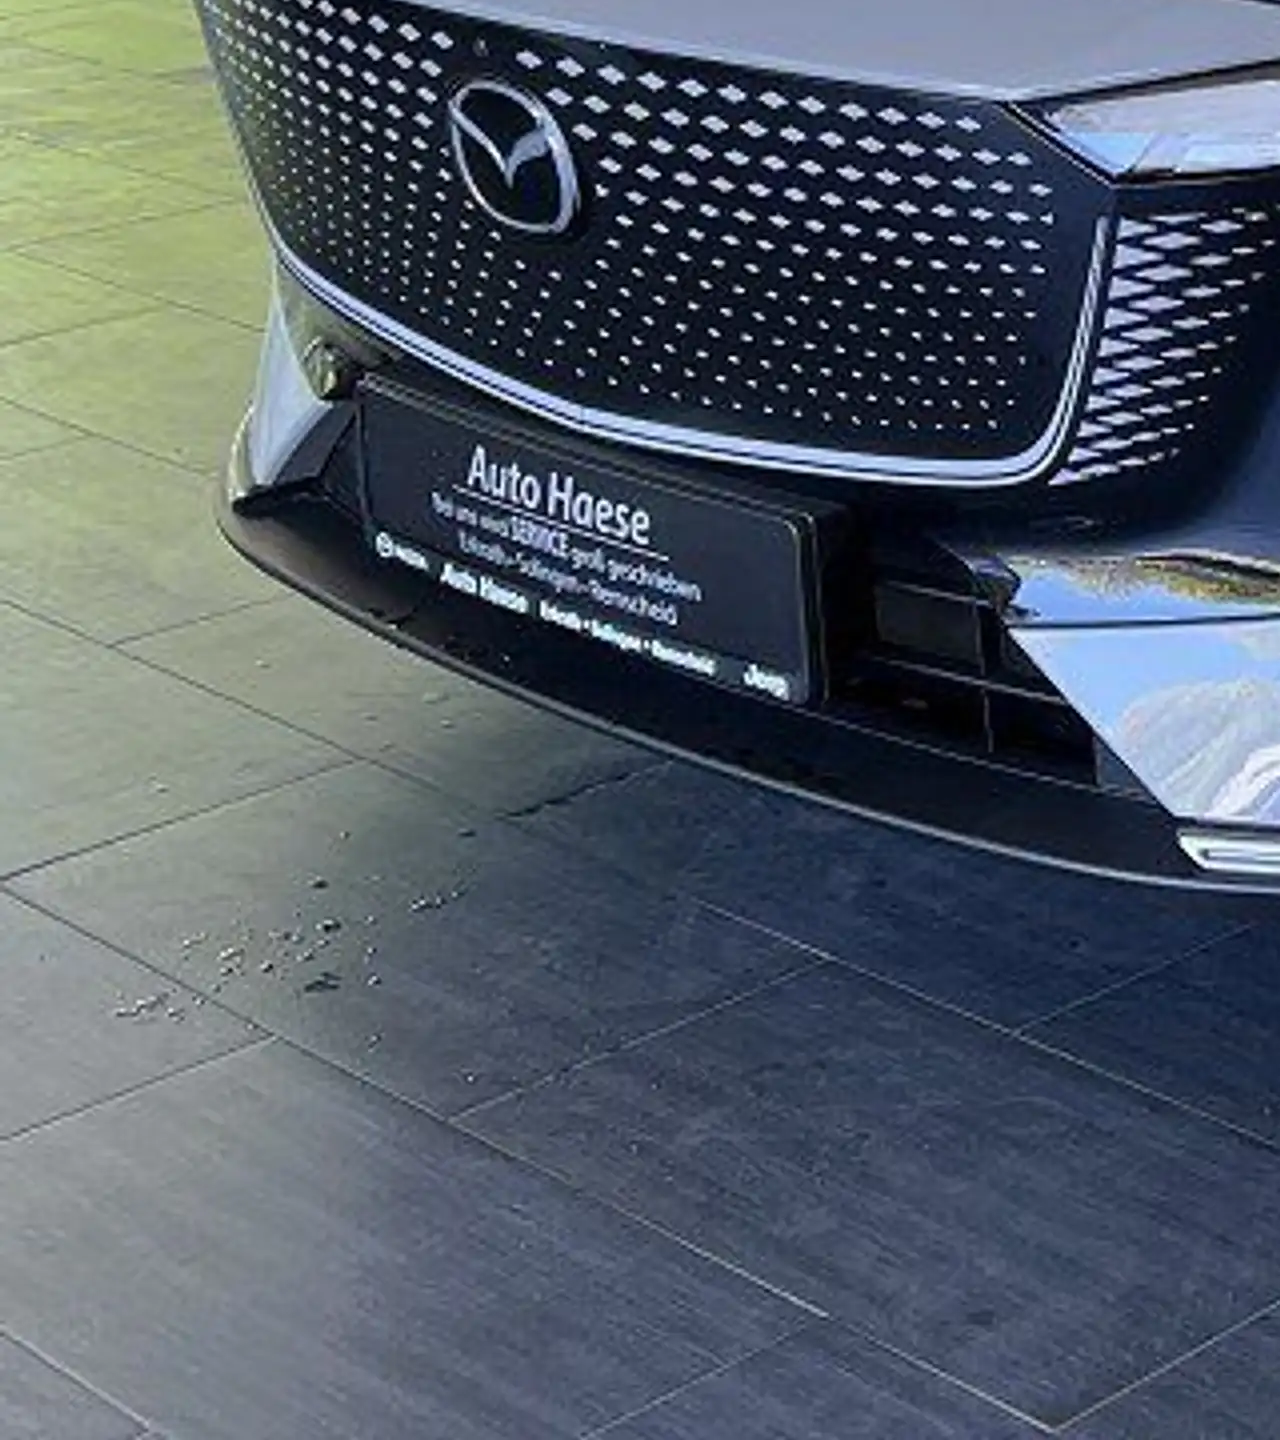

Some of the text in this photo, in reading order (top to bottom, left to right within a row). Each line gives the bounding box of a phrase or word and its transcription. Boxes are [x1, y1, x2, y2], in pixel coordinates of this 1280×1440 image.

[466, 444, 650, 546] Auto Haese
[439, 562, 478, 594] Auto
[510, 515, 569, 559] SERVICE
[606, 559, 702, 602] geschrieben
